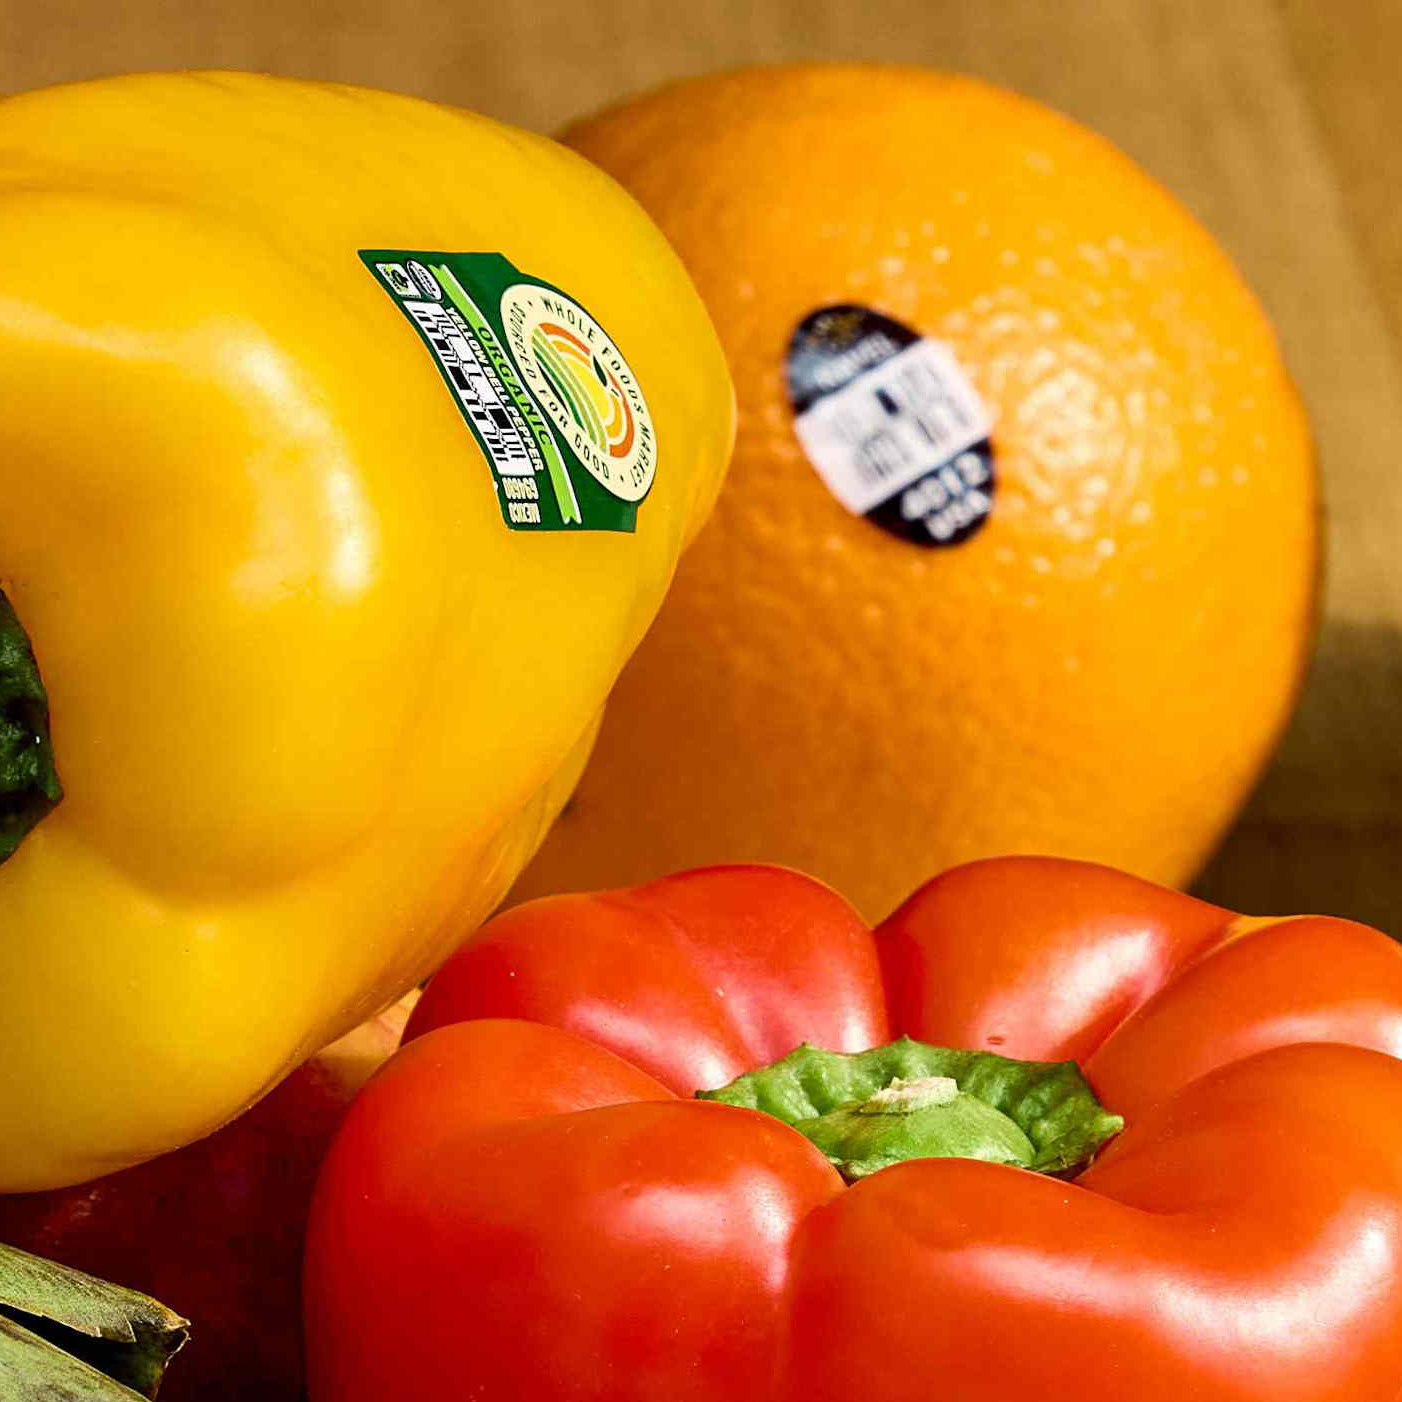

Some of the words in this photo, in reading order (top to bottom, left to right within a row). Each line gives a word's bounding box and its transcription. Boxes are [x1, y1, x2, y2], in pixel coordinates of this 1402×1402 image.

[446, 307, 489, 364] YELLOW
[483, 367, 510, 404] BELL
[506, 406, 544, 471] PEPPER
[479, 327, 553, 445] ORGANIC
[541, 296, 597, 343] WHOLE
[602, 347, 644, 414] FOODS
[575, 433, 610, 480] GOOD
